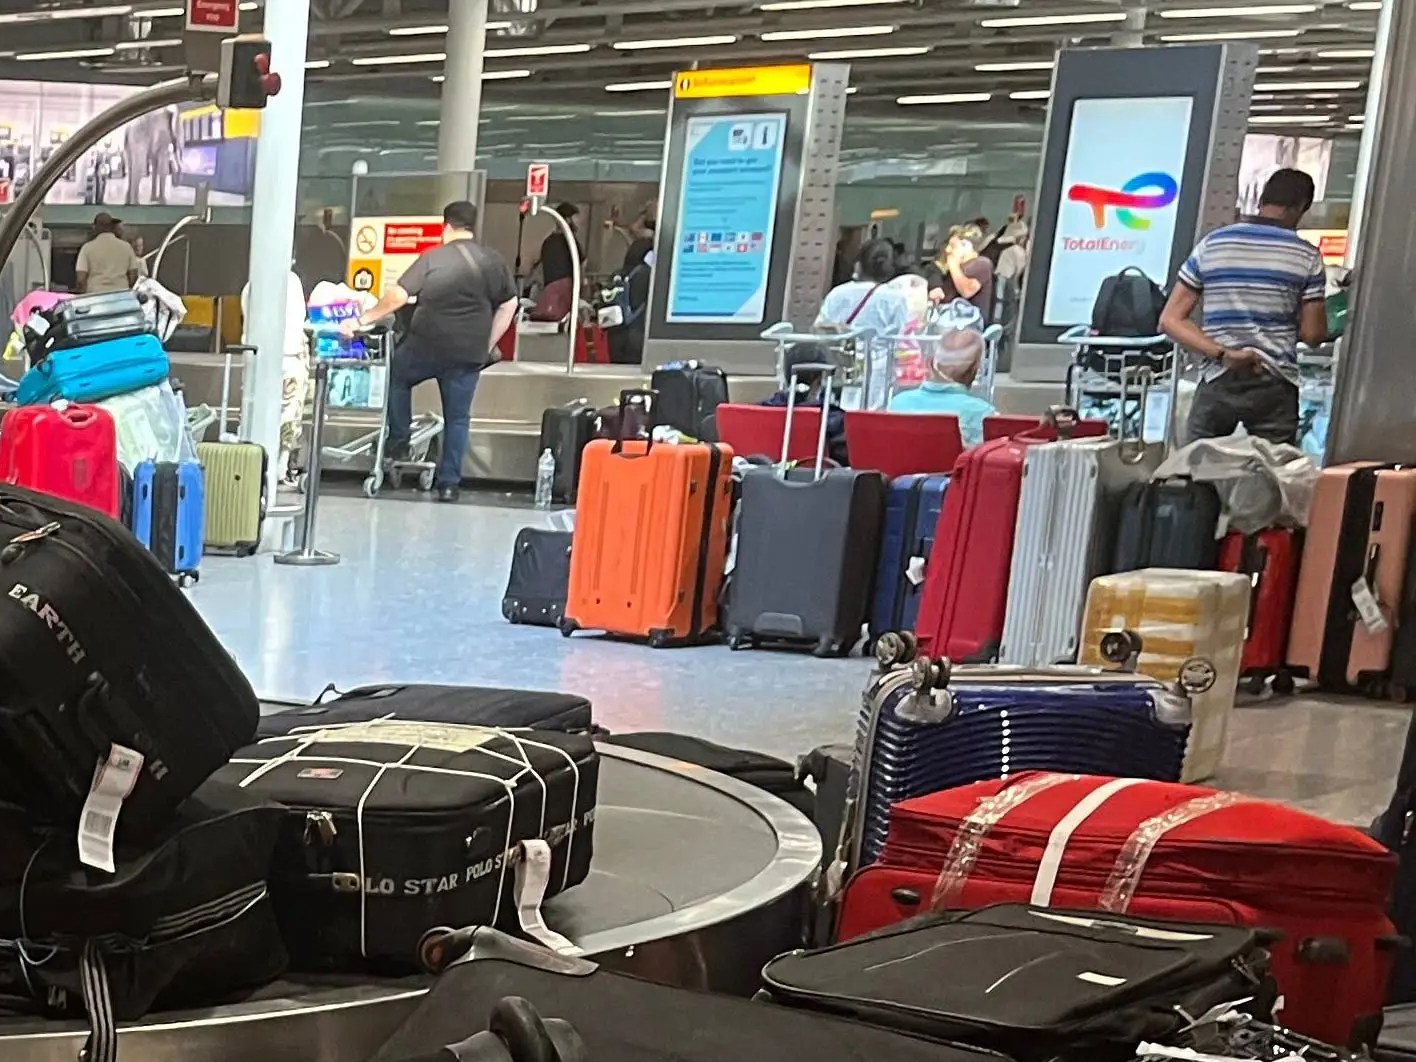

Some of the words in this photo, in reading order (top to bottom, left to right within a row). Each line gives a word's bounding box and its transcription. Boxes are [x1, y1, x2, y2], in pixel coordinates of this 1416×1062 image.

[7, 583, 87, 664] EARTH
[403, 873, 458, 895] STAR
[465, 858, 493, 882] POLO
